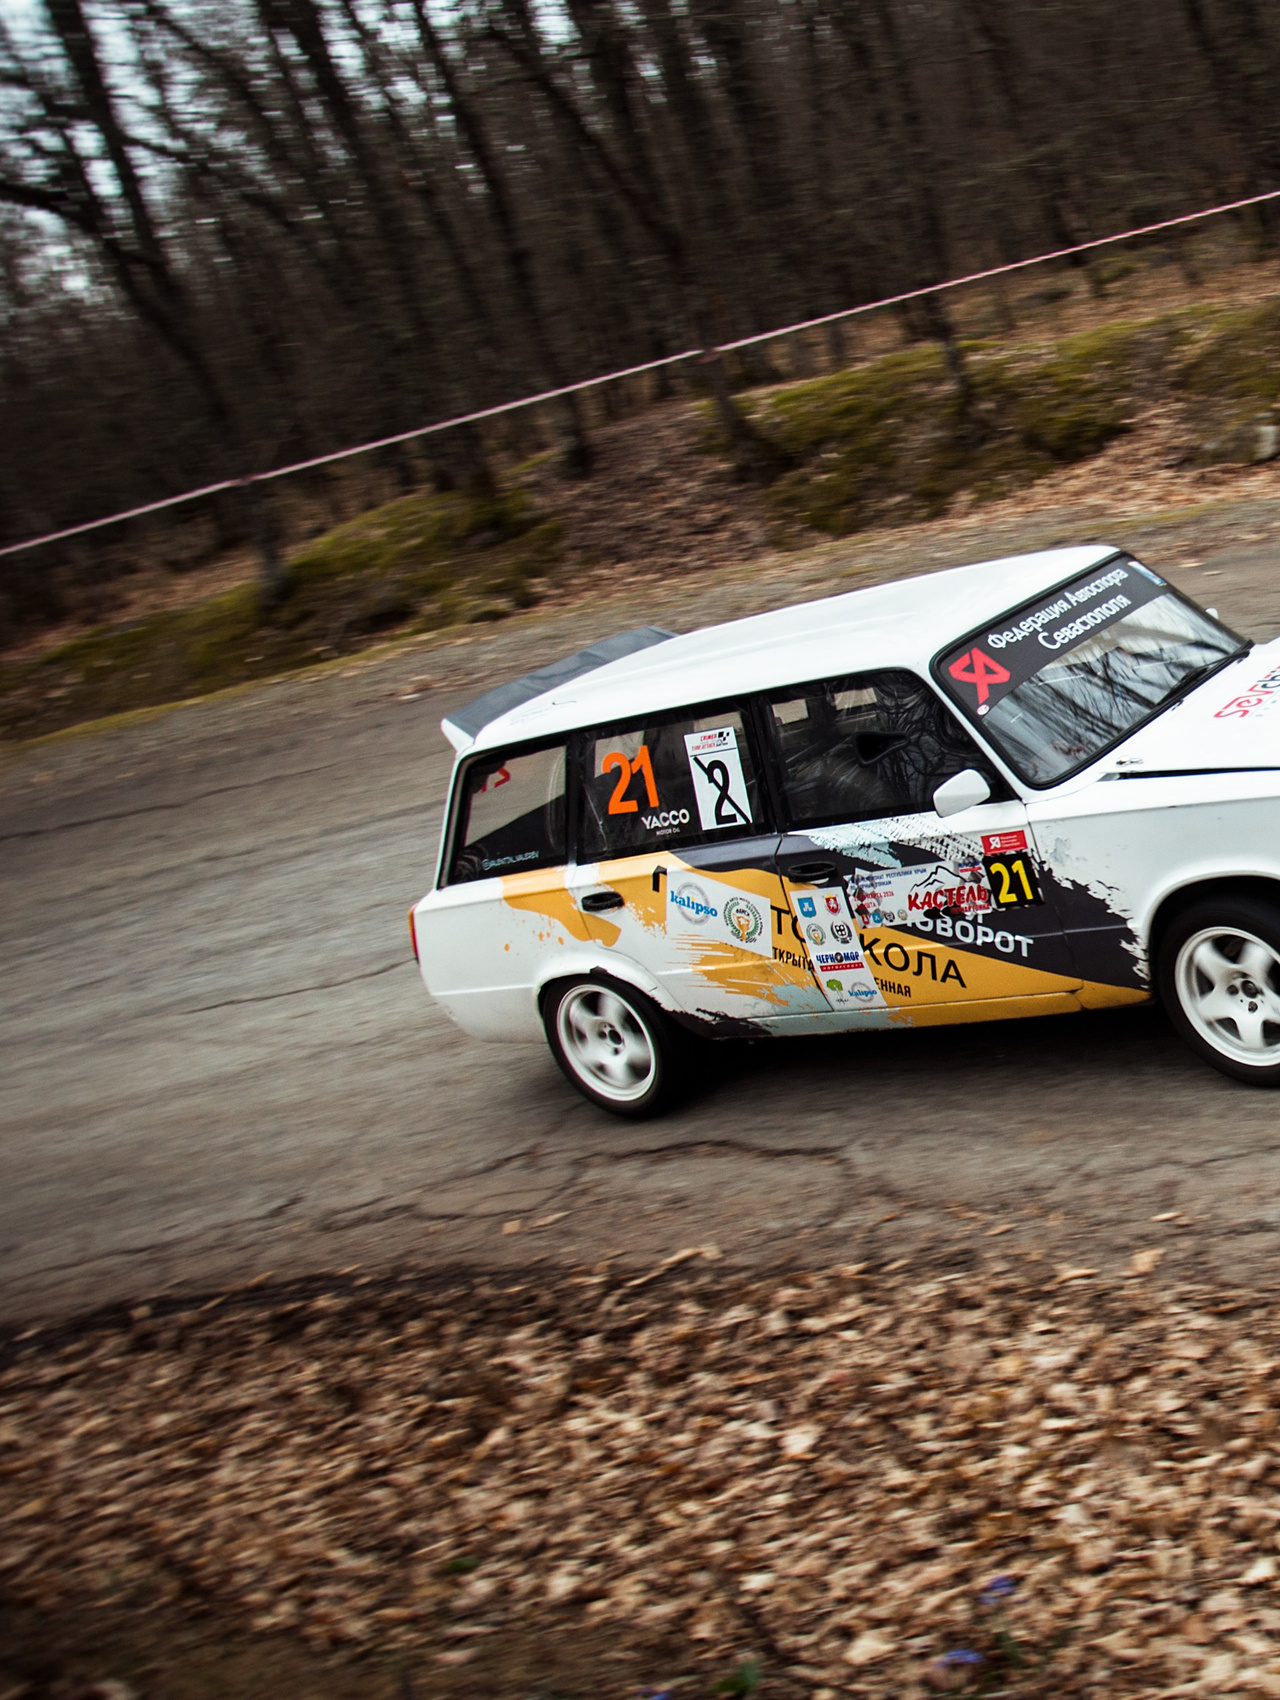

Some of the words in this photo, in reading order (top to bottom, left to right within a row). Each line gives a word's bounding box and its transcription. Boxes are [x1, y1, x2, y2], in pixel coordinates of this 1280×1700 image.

[988, 599, 1071, 649] Федерация
[1064, 568, 1129, 607] Автоспорта
[1038, 594, 1132, 650] Севастополя
[602, 744, 660, 815] 21
[706, 760, 738, 826] 2
[641, 808, 690, 830] YACCO
[908, 884, 988, 911] КАСТЕЛЬ
[989, 859, 1034, 904] 21
[670, 890, 718, 918] kalipso
[905, 915, 1034, 957] ОВОРОТ
[874, 977, 911, 998] ЕННАЯ
